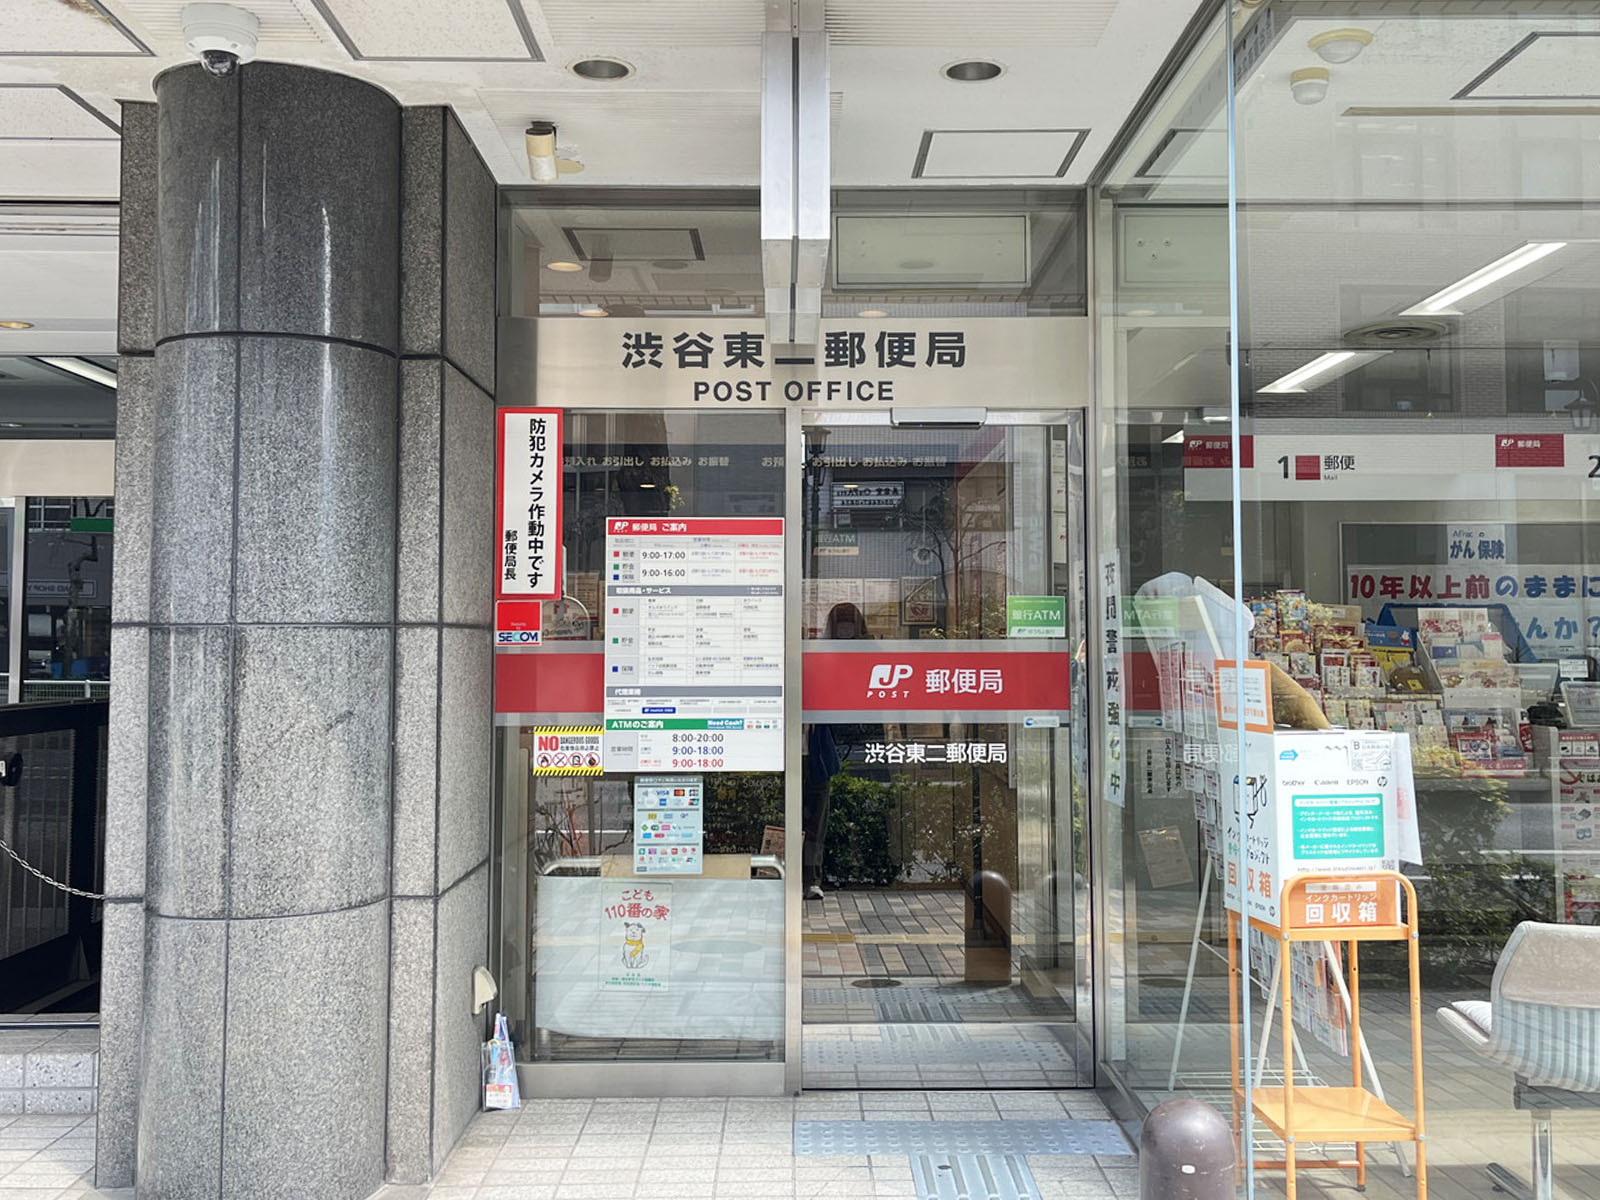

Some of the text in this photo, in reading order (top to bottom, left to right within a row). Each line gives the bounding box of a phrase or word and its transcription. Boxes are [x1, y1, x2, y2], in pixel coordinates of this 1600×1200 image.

[693, 380, 894, 402] POST OFFICE
[1278, 455, 1356, 479] 1 郵便
[1587, 455, 1600, 478] 2
[527, 418, 547, 588] 防犯カメラ作動中です
[632, 523, 658, 532] 郵便局
[661, 523, 687, 532] ご案内
[504, 530, 518, 581] 郵便局長
[641, 551, 686, 560] 9:00-17:00
[1450, 539, 1505, 560] がん保険
[641, 569, 686, 578] 9:00-16:00
[1350, 574, 1600, 600] 10年以上前のままに
[1012, 609, 1061, 621] 銀行ATM
[498, 631, 539, 643] SECOM
[925, 668, 1004, 694] 郵便局
[866, 690, 910, 698] POST
[611, 720, 664, 729] ATMのご案内
[538, 735, 560, 751] NO
[672, 733, 724, 743] 8:00-20:00
[672, 746, 724, 755] 9:00-18:00
[864, 742, 1007, 764] 渋谷東二郵便局
[672, 758, 724, 768] 9:00-18:00
[621, 888, 654, 902] こども
[604, 902, 670, 921] 110番の家
[1305, 901, 1378, 925] 回収箱
